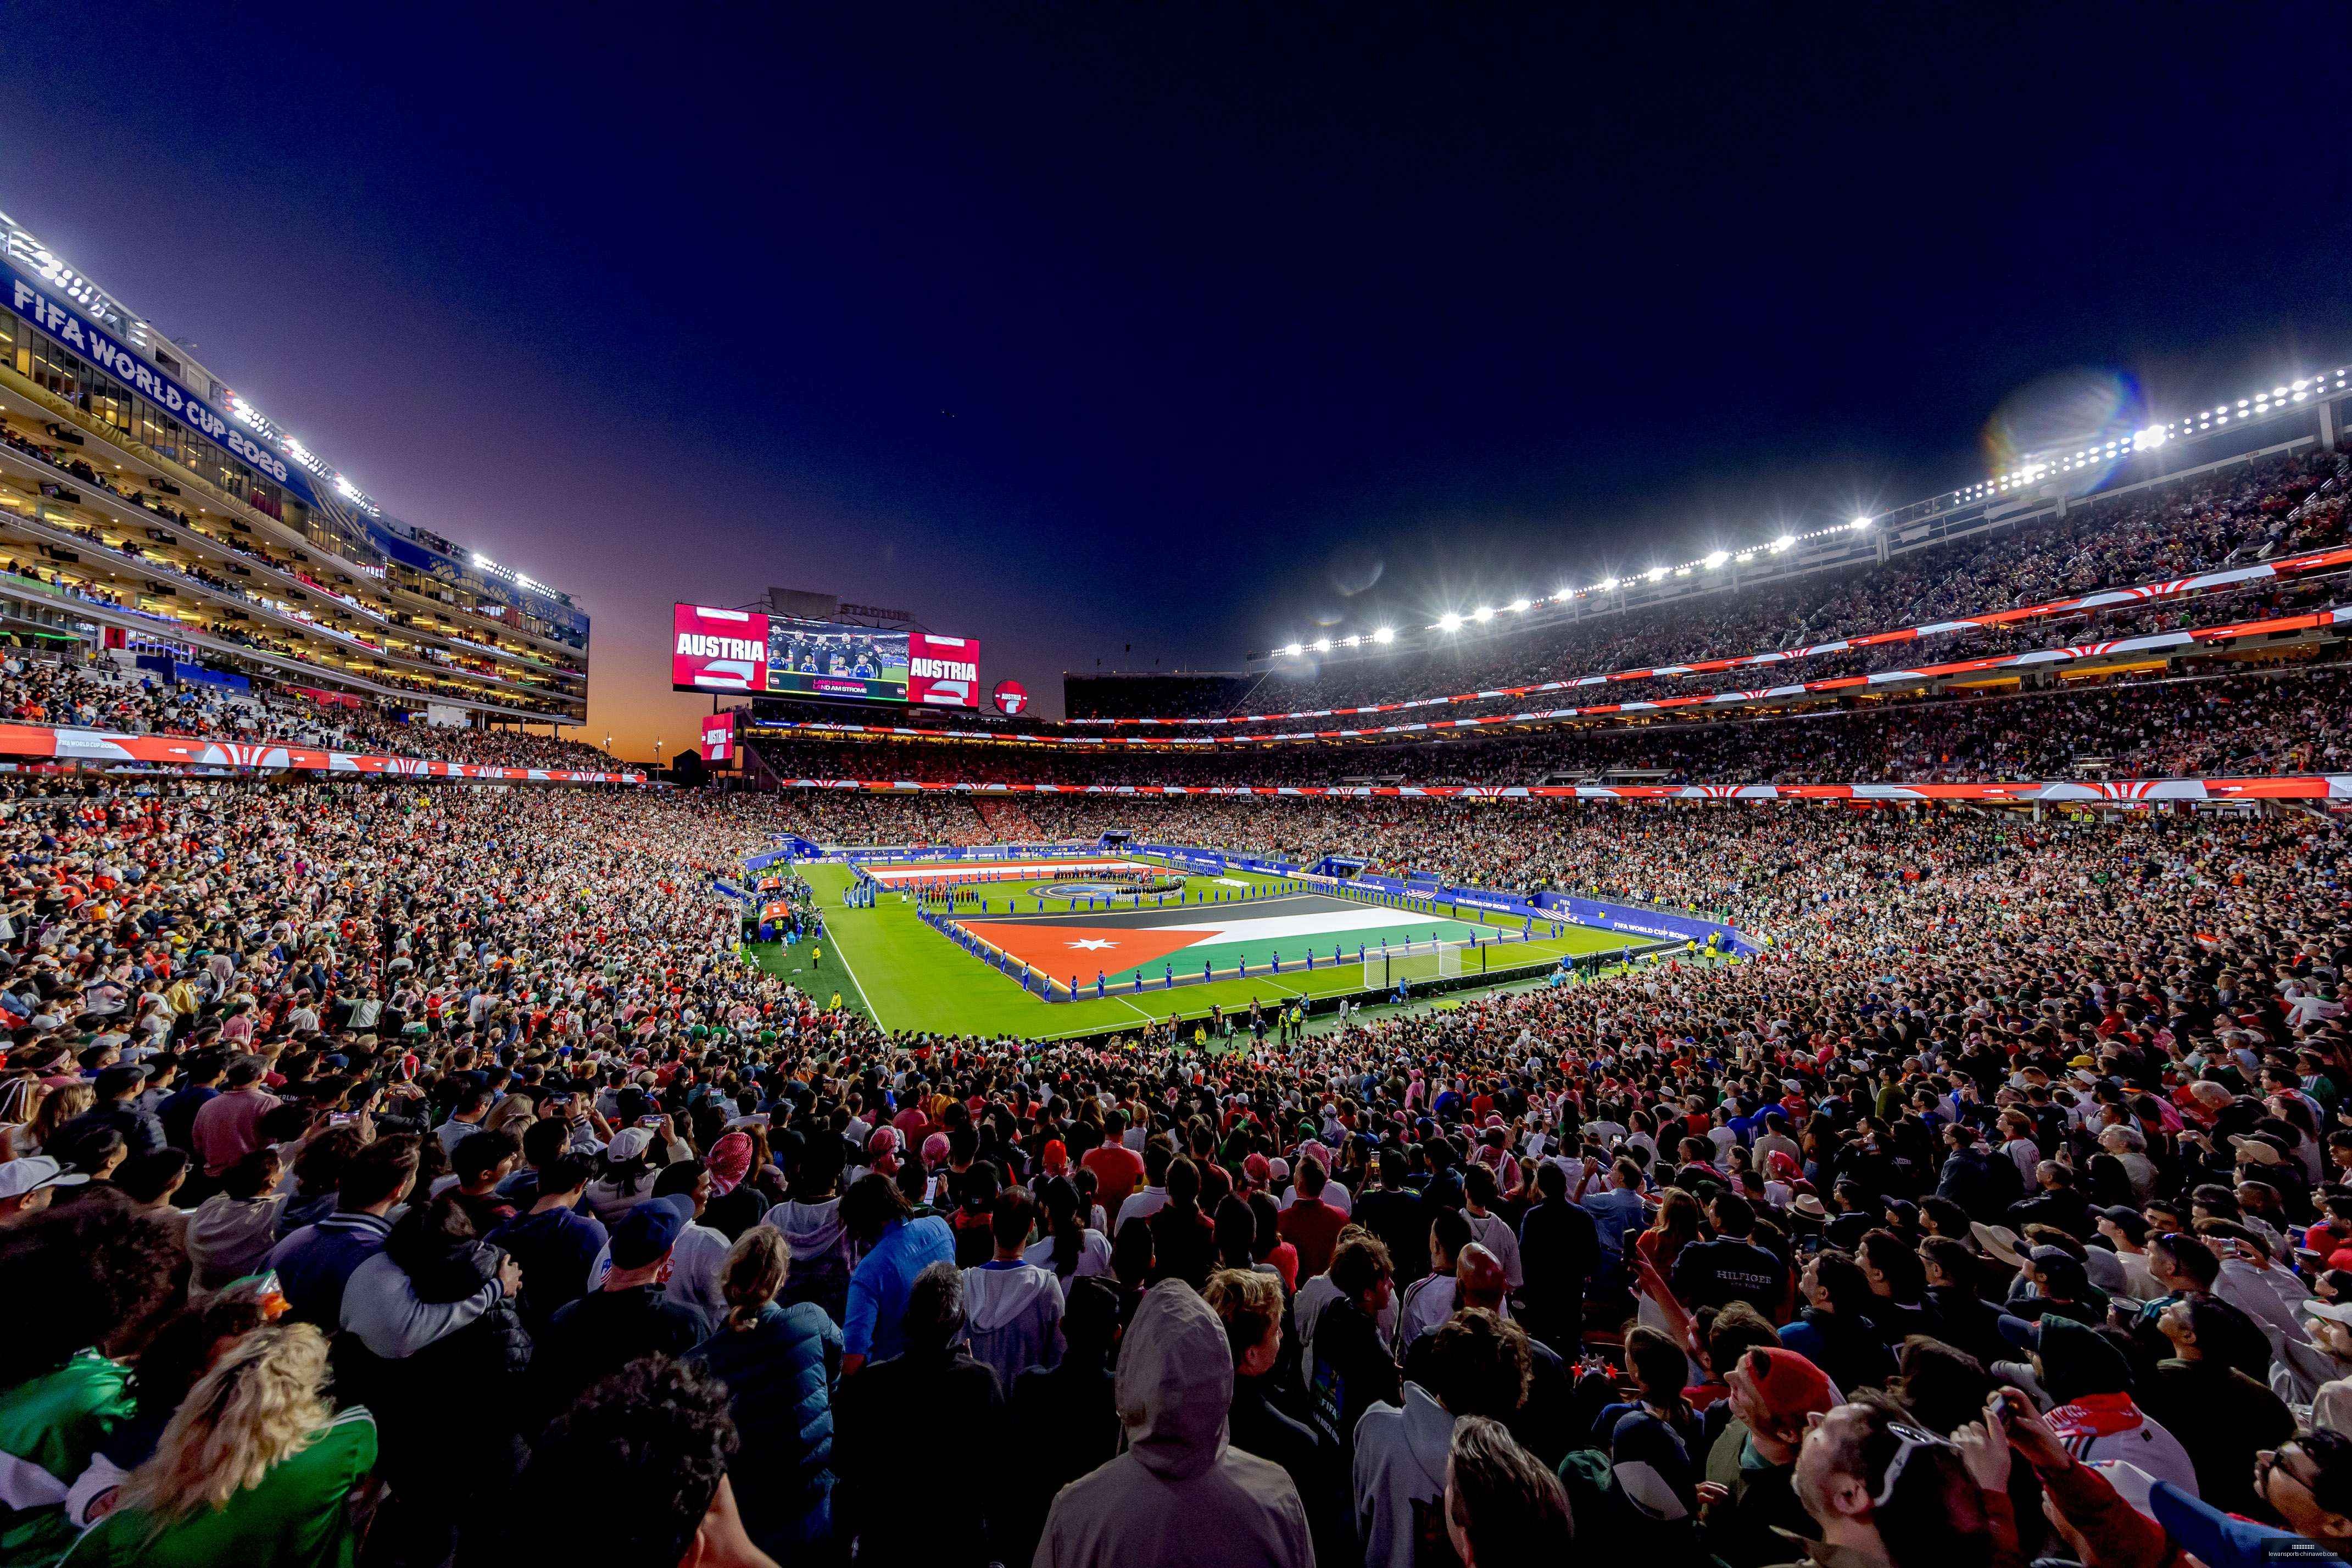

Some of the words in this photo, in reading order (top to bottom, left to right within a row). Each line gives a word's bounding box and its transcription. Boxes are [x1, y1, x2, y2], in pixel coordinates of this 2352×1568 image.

[14, 279, 85, 350] FIFA
[89, 330, 185, 411] WORLD
[186, 401, 227, 438] CUP
[228, 430, 288, 482] 2026
[676, 633, 765, 662] AUSTRIA
[910, 657, 977, 682] AUSTRIA
[1001, 693, 1022, 701] AUSTRIA
[707, 728, 726, 745] AUSTRIA
[1614, 922, 1629, 930] FIFA
[1629, 924, 1653, 934] WORLD
[1668, 931, 1690, 940] 2026
[1716, 1270, 1771, 1284] HILFIGER
[1321, 1397, 1336, 1421] FIFA
